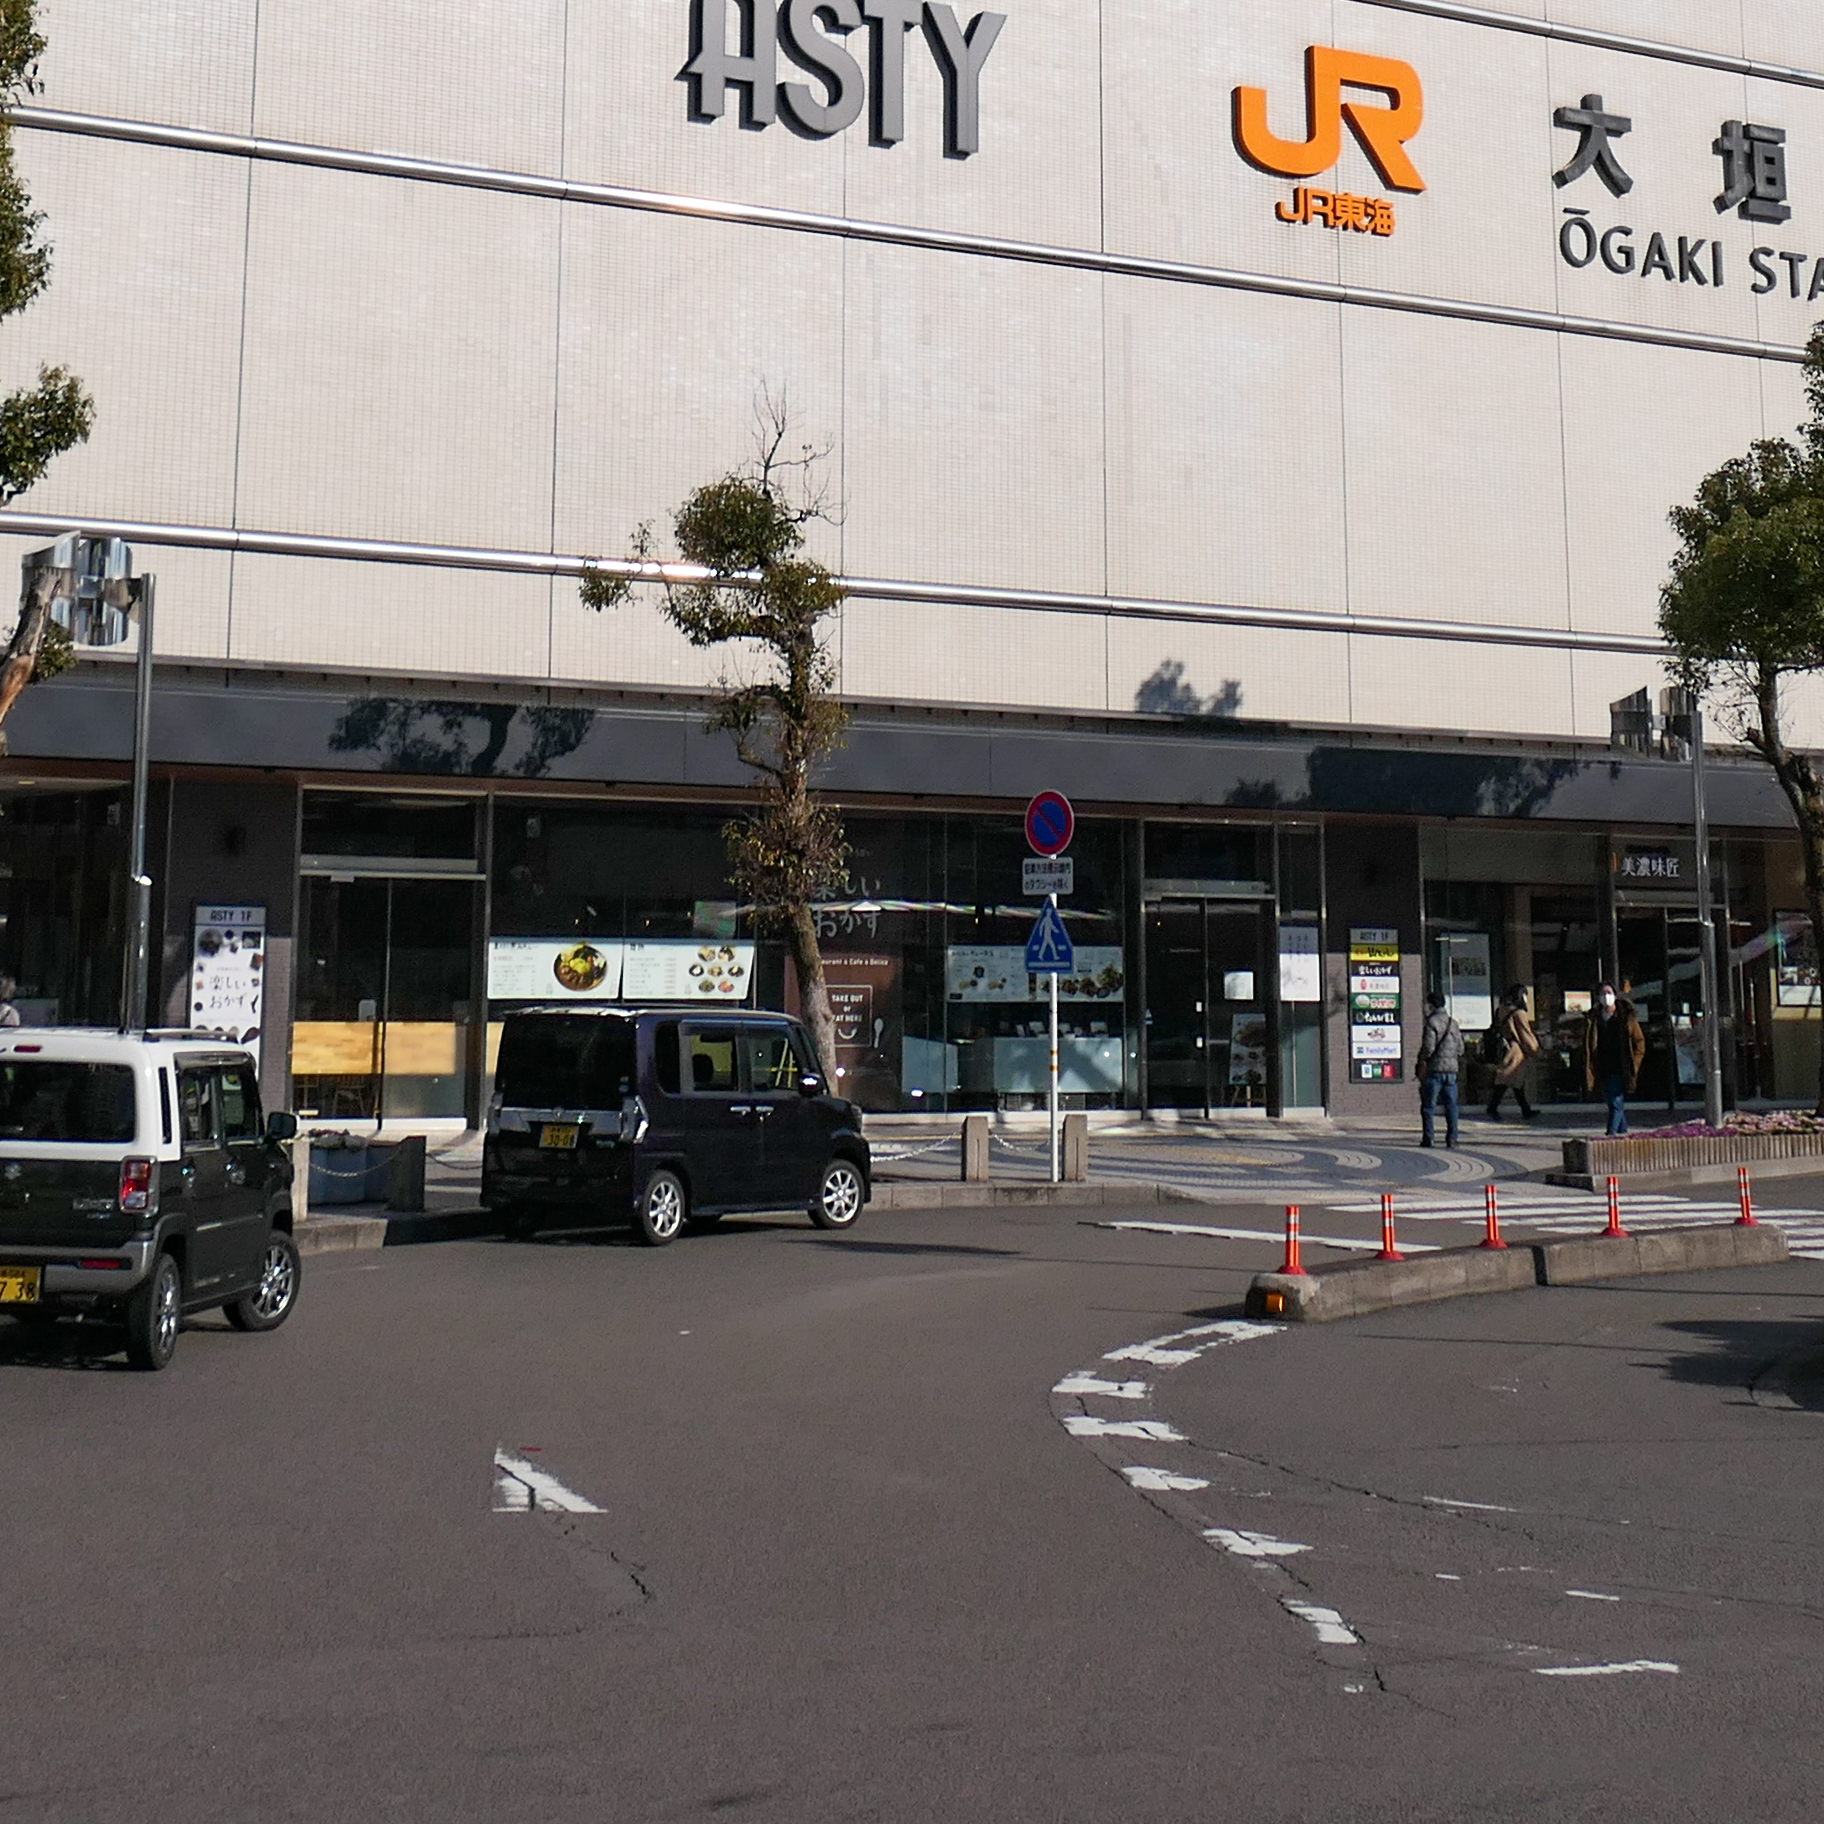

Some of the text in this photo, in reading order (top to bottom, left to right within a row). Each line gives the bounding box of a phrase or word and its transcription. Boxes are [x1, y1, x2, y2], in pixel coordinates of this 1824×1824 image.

[1231, 45, 1427, 195] JR
[1275, 187, 1395, 237] JR東海
[1621, 857, 1680, 877] 美濃味匠
[210, 910, 252, 921] ASTY 1F
